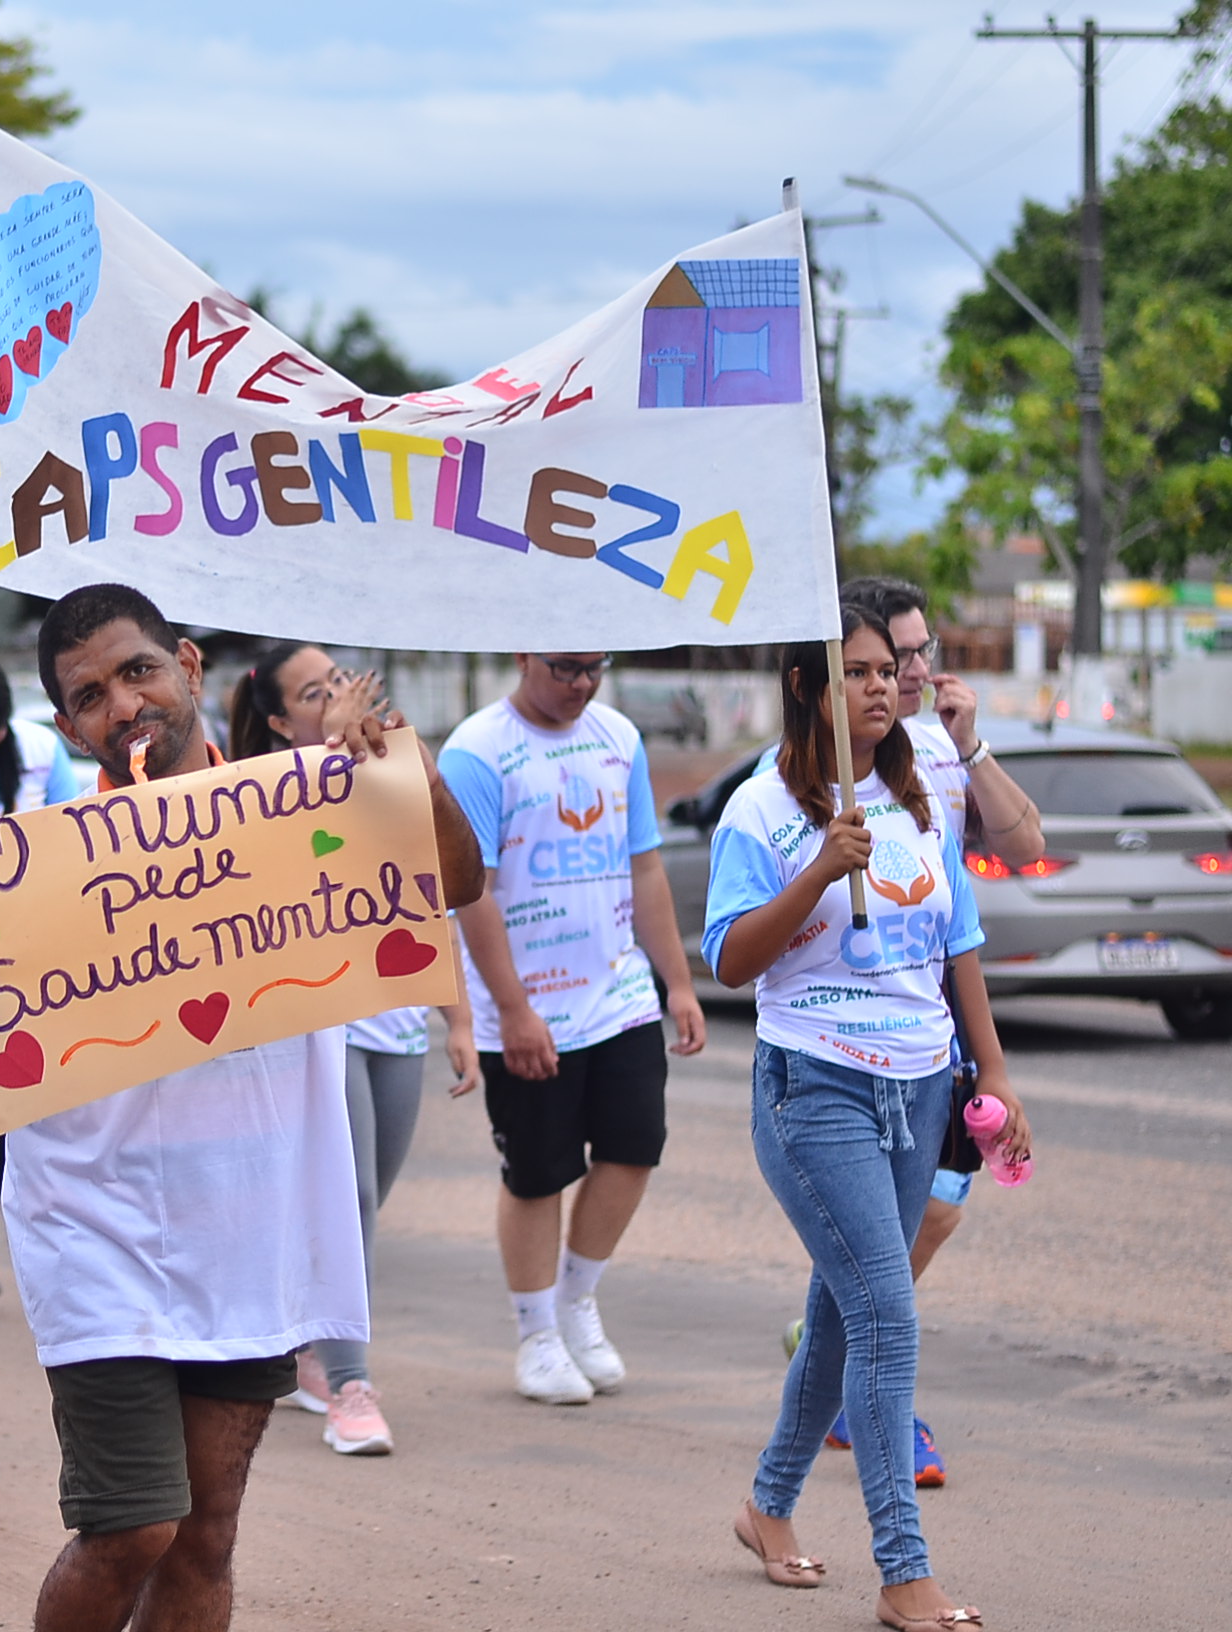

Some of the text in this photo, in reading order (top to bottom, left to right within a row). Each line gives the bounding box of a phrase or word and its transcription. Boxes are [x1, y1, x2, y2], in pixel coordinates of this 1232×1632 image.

[81, 848, 251, 933] pede
[837, 1016, 923, 1035] RESILIÊNCIA
[881, 1057, 891, 1068] A
